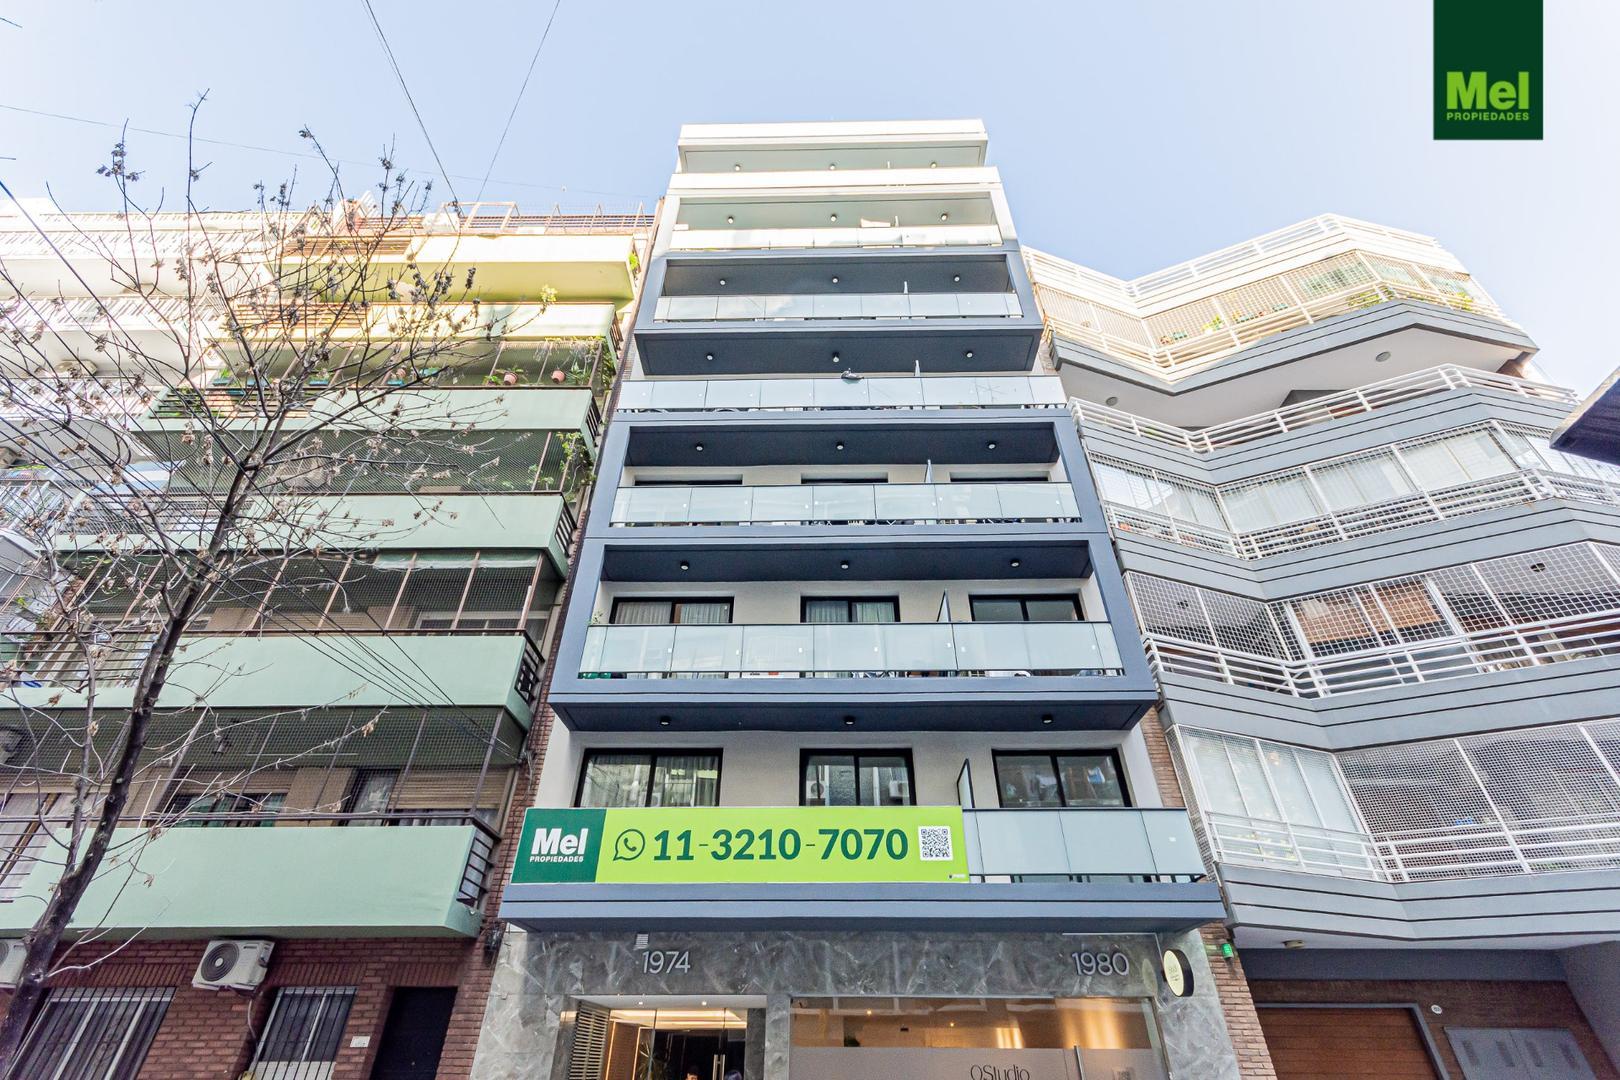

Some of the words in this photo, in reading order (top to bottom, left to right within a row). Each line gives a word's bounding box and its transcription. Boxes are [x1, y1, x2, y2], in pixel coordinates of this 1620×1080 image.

[531, 828, 589, 855] Mel
[653, 828, 909, 862] 11-3210-7070
[529, 855, 584, 863] PROPIEDADES
[642, 950, 691, 974] 1974
[1072, 951, 1130, 976] 1980
